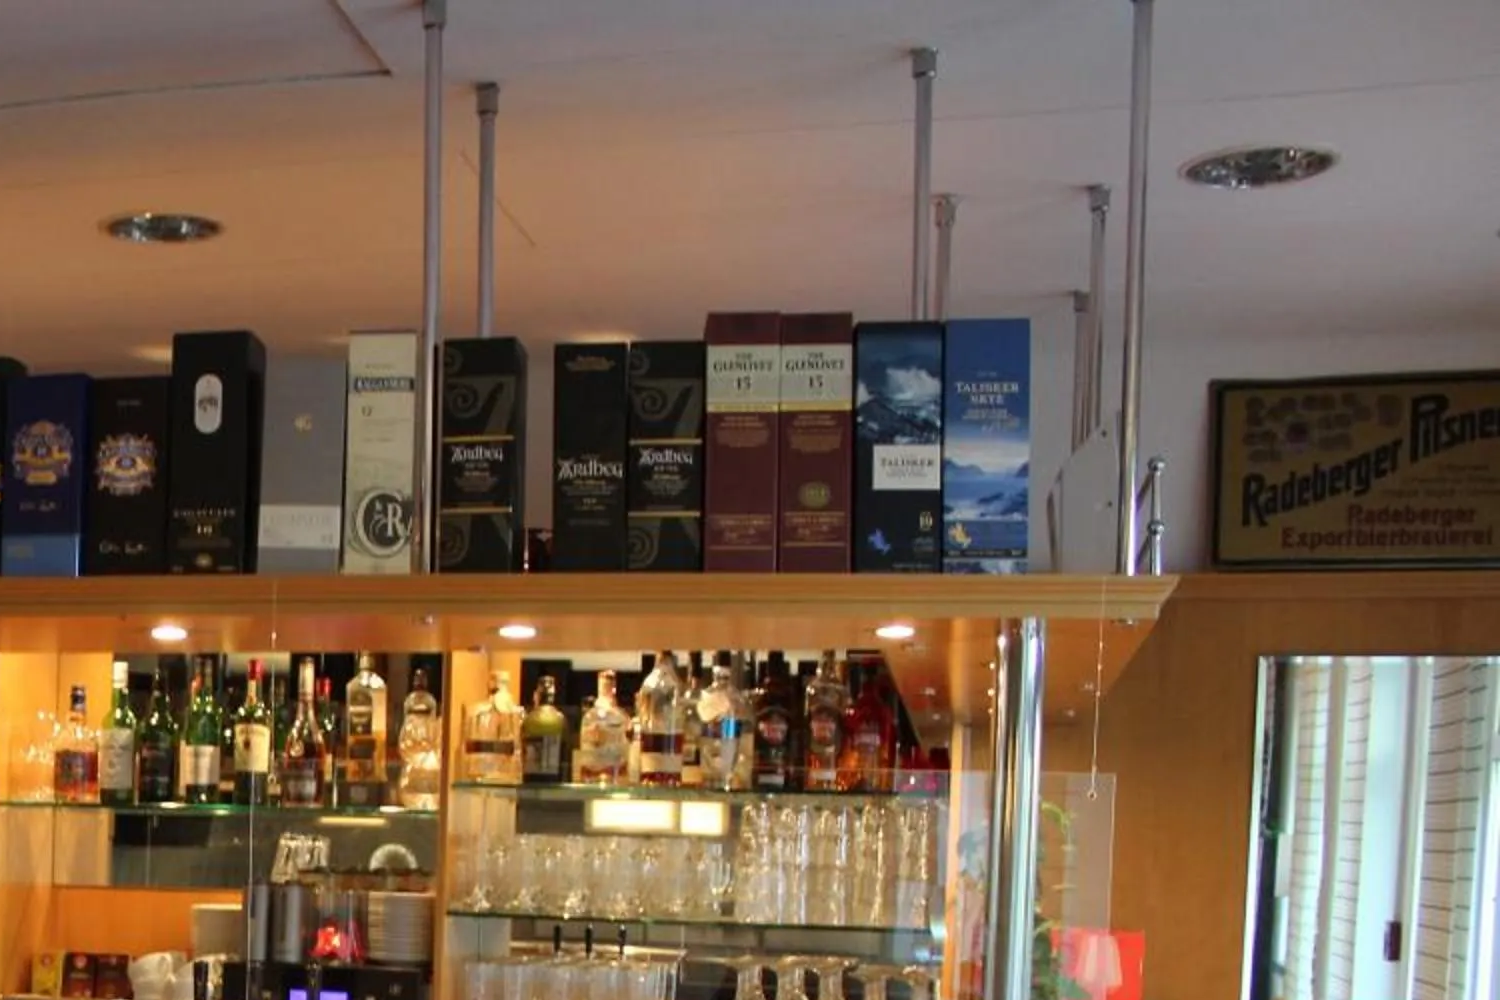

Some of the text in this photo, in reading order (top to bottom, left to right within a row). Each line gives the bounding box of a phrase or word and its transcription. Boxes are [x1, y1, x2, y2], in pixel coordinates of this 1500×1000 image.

[785, 359, 845, 372] GLENLIVET
[808, 375, 823, 389] 15
[956, 381, 1019, 393] TALISKER
[638, 446, 694, 466] Ardbeg
[1241, 393, 1500, 527] Radeberger Pilsne
[557, 457, 624, 481] Ardbeg
[1348, 505, 1477, 526] Radeberger
[1280, 526, 1494, 551] Exportbierbrauerei
